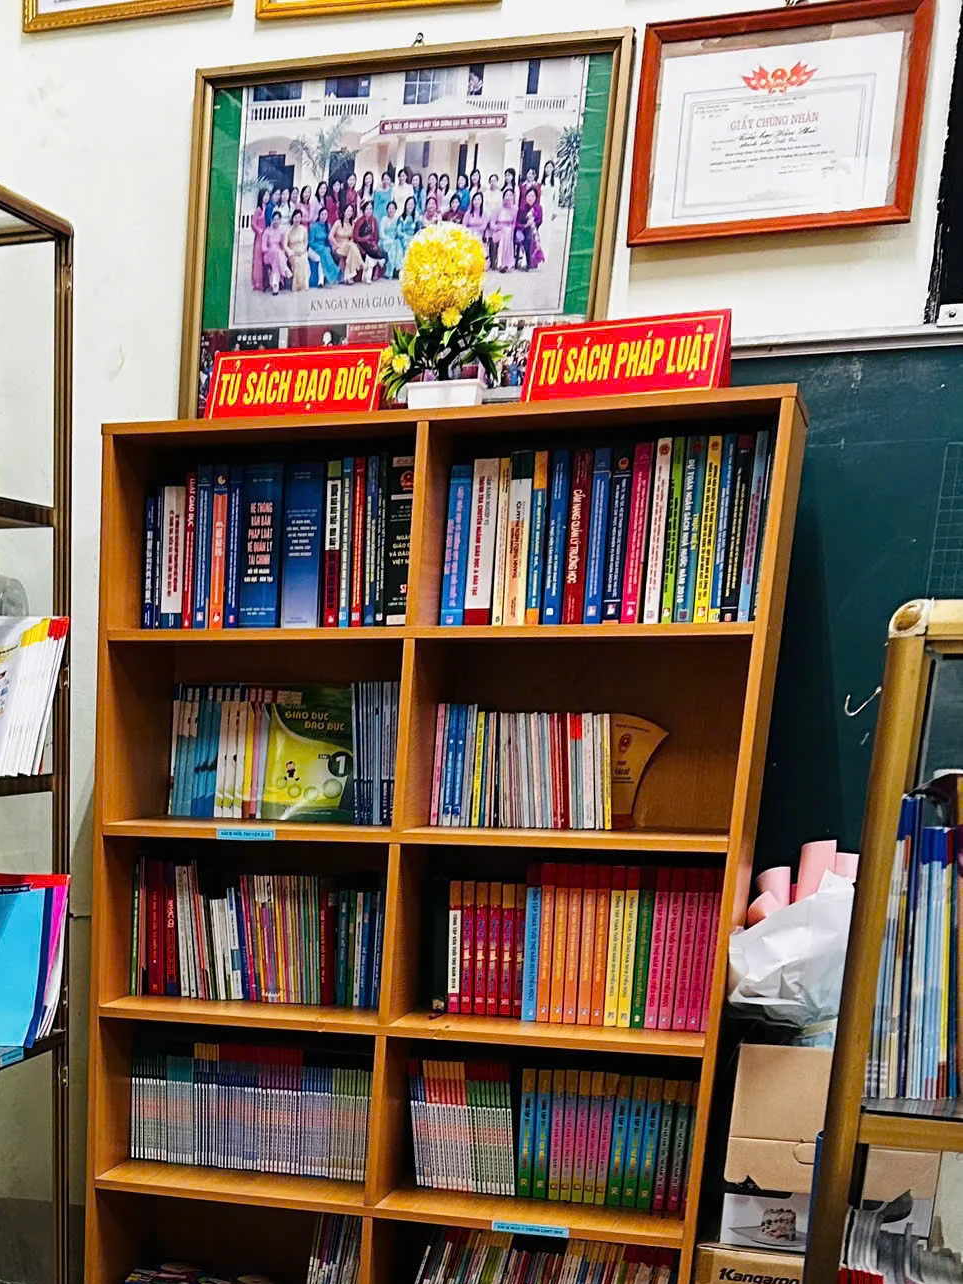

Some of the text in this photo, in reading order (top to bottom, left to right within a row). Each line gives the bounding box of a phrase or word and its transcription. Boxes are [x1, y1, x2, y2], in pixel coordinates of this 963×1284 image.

[311, 300, 323, 311] KN
[324, 296, 349, 310] NGÀY
[351, 297, 370, 309] NHÀ
[372, 296, 395, 309] GIÁO
[539, 325, 714, 386] TỦ SÁCH PHÁP LUẬT
[217, 358, 372, 410] TỦ SÁCH ĐẠO ĐỨC
[336, 755, 345, 774] 1
